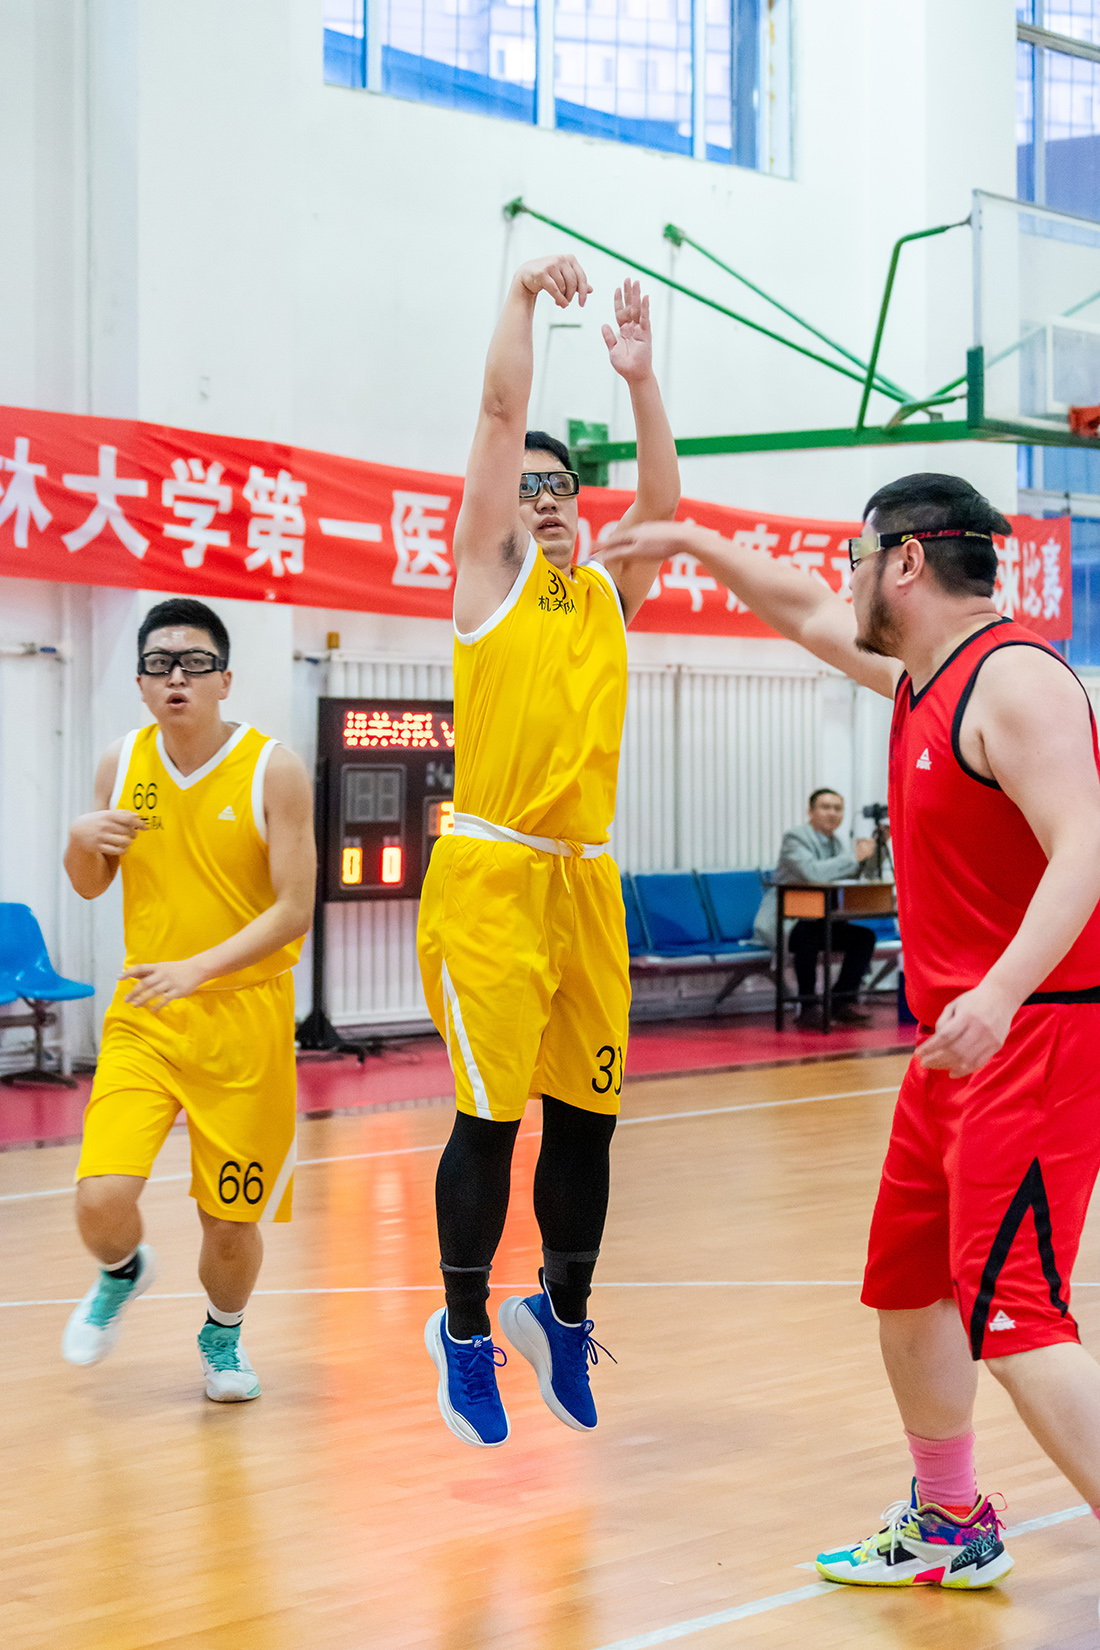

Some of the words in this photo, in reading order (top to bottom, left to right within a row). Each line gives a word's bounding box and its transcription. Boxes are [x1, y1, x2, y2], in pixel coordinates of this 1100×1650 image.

[538, 595, 577, 615] 机关队
[133, 782, 158, 811] 66
[219, 1160, 263, 1205] 66
